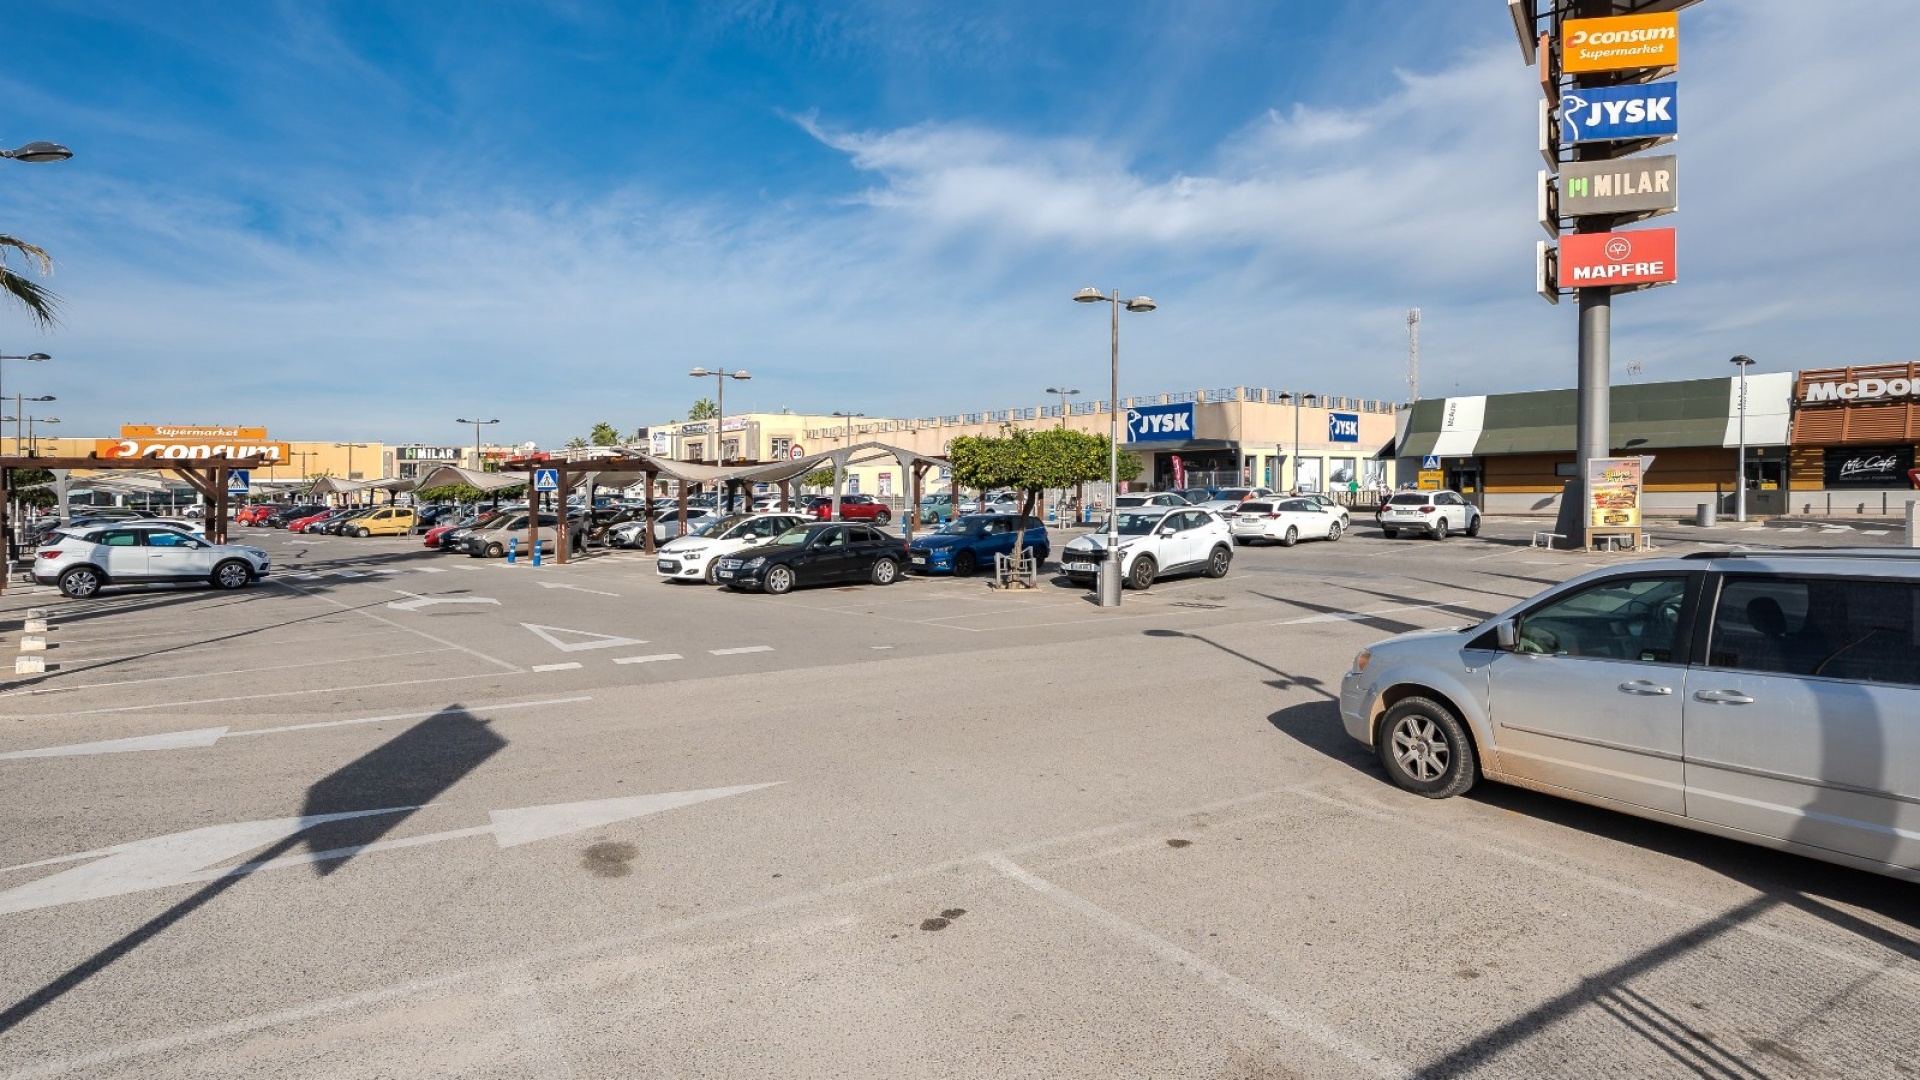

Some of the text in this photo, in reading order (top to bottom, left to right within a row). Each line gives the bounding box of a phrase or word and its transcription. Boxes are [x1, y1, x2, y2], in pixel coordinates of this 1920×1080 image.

[1588, 26, 1675, 45] consum
[1579, 44, 1664, 60] Supermarket
[1585, 97, 1672, 127] JYSK
[1593, 170, 1669, 197] MILAR
[1573, 261, 1664, 279] MAPFRE
[155, 426, 239, 438] Supermarket
[1139, 412, 1190, 434] JYSK
[1334, 420, 1358, 436] JYSK
[417, 448, 454, 459] MILAR
[1840, 455, 1897, 474] McCafé
